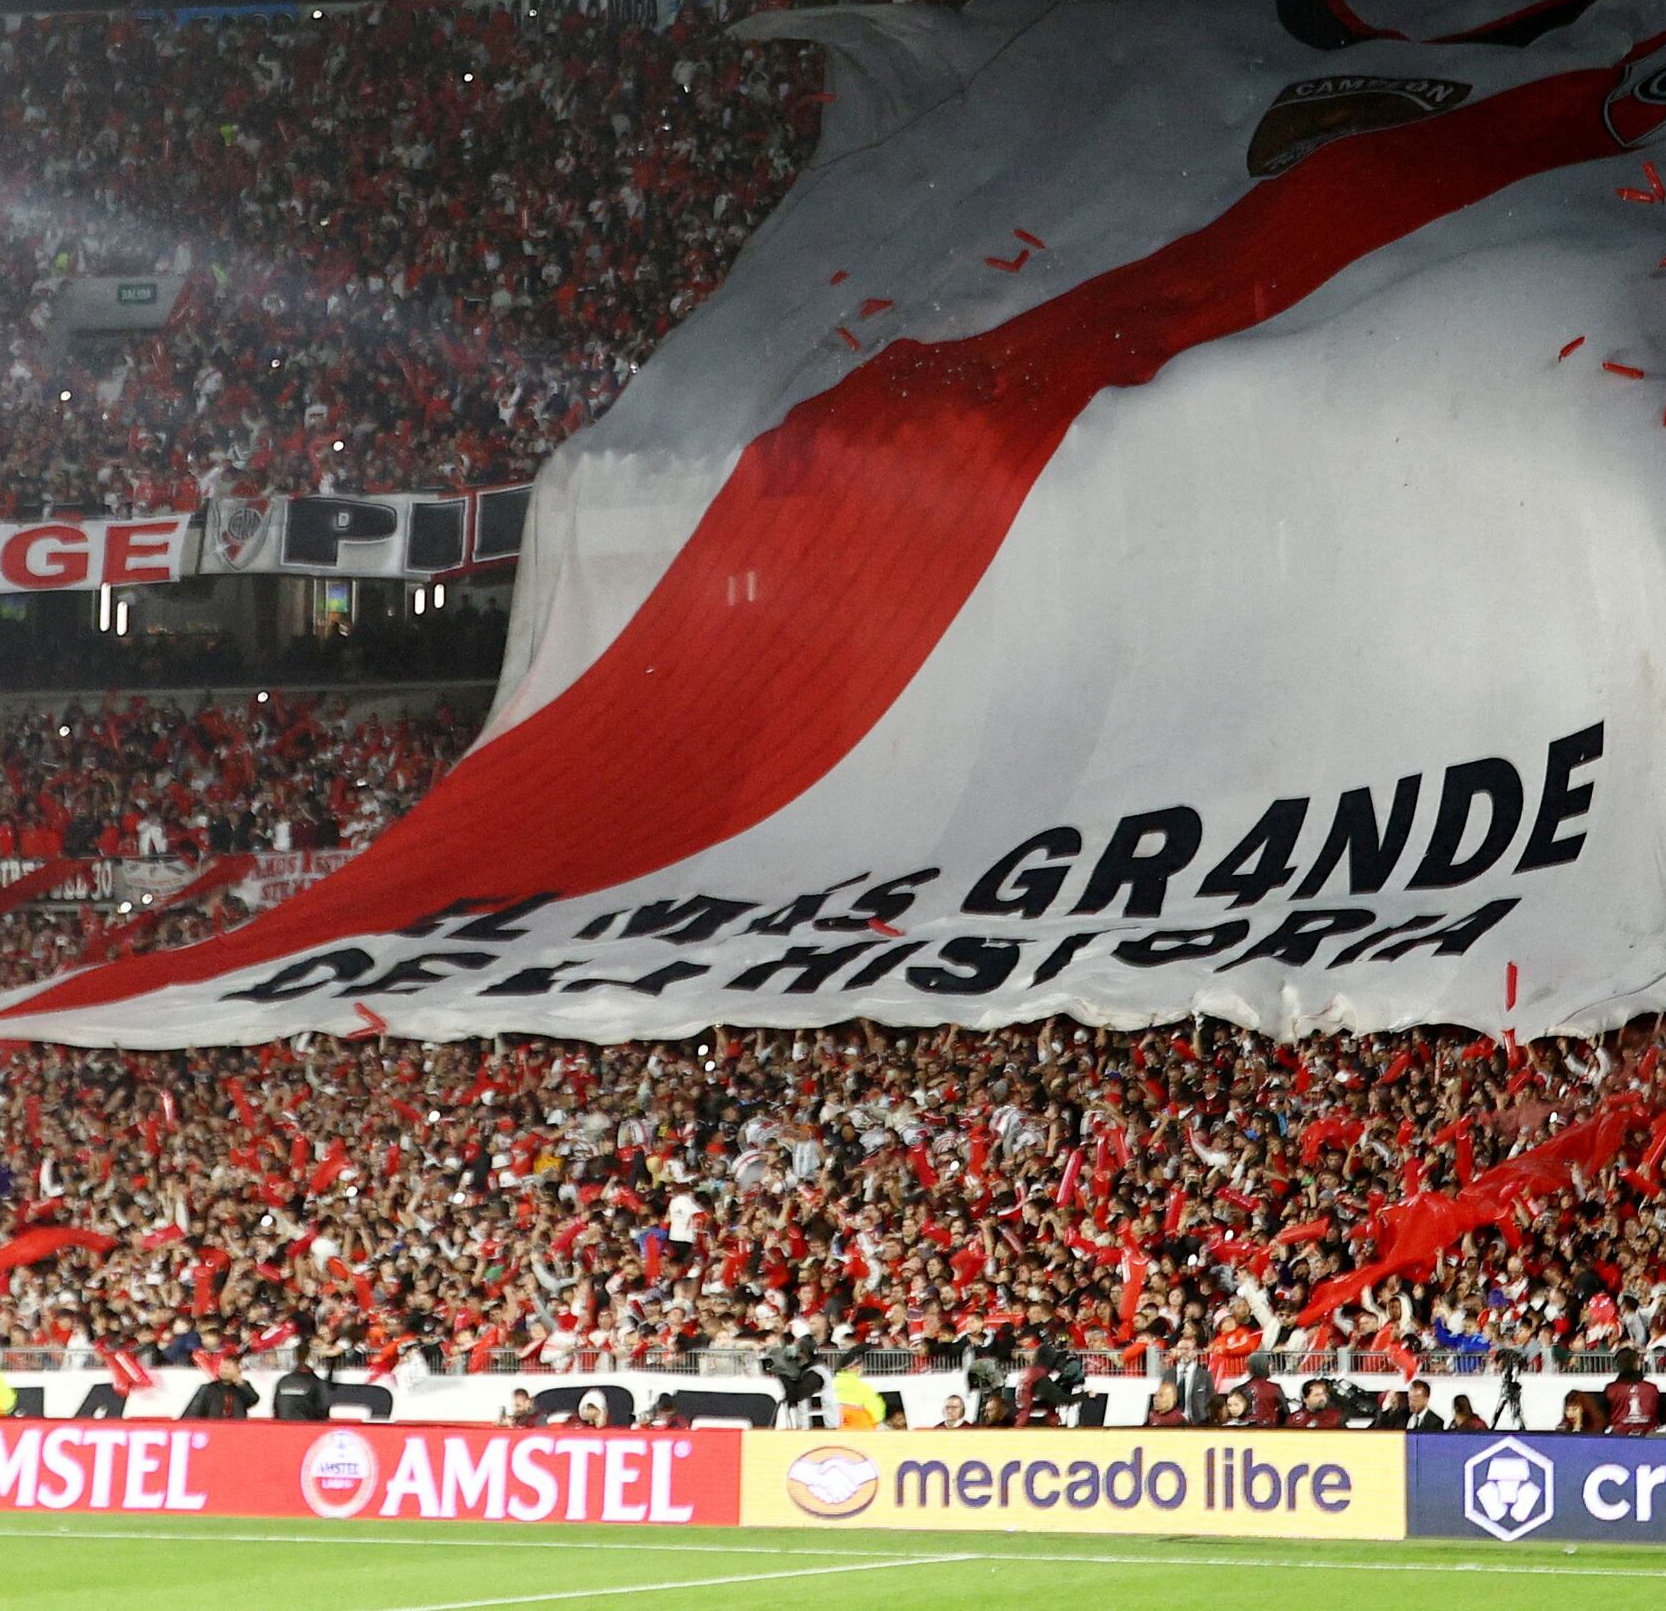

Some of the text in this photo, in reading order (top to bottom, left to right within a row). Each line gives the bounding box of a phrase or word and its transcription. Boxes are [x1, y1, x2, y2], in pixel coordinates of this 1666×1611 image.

[960, 720, 1606, 921] GR4NDE
[380, 1435, 695, 1524] AMSTEL
[894, 1445, 1353, 1513] mercado libre
